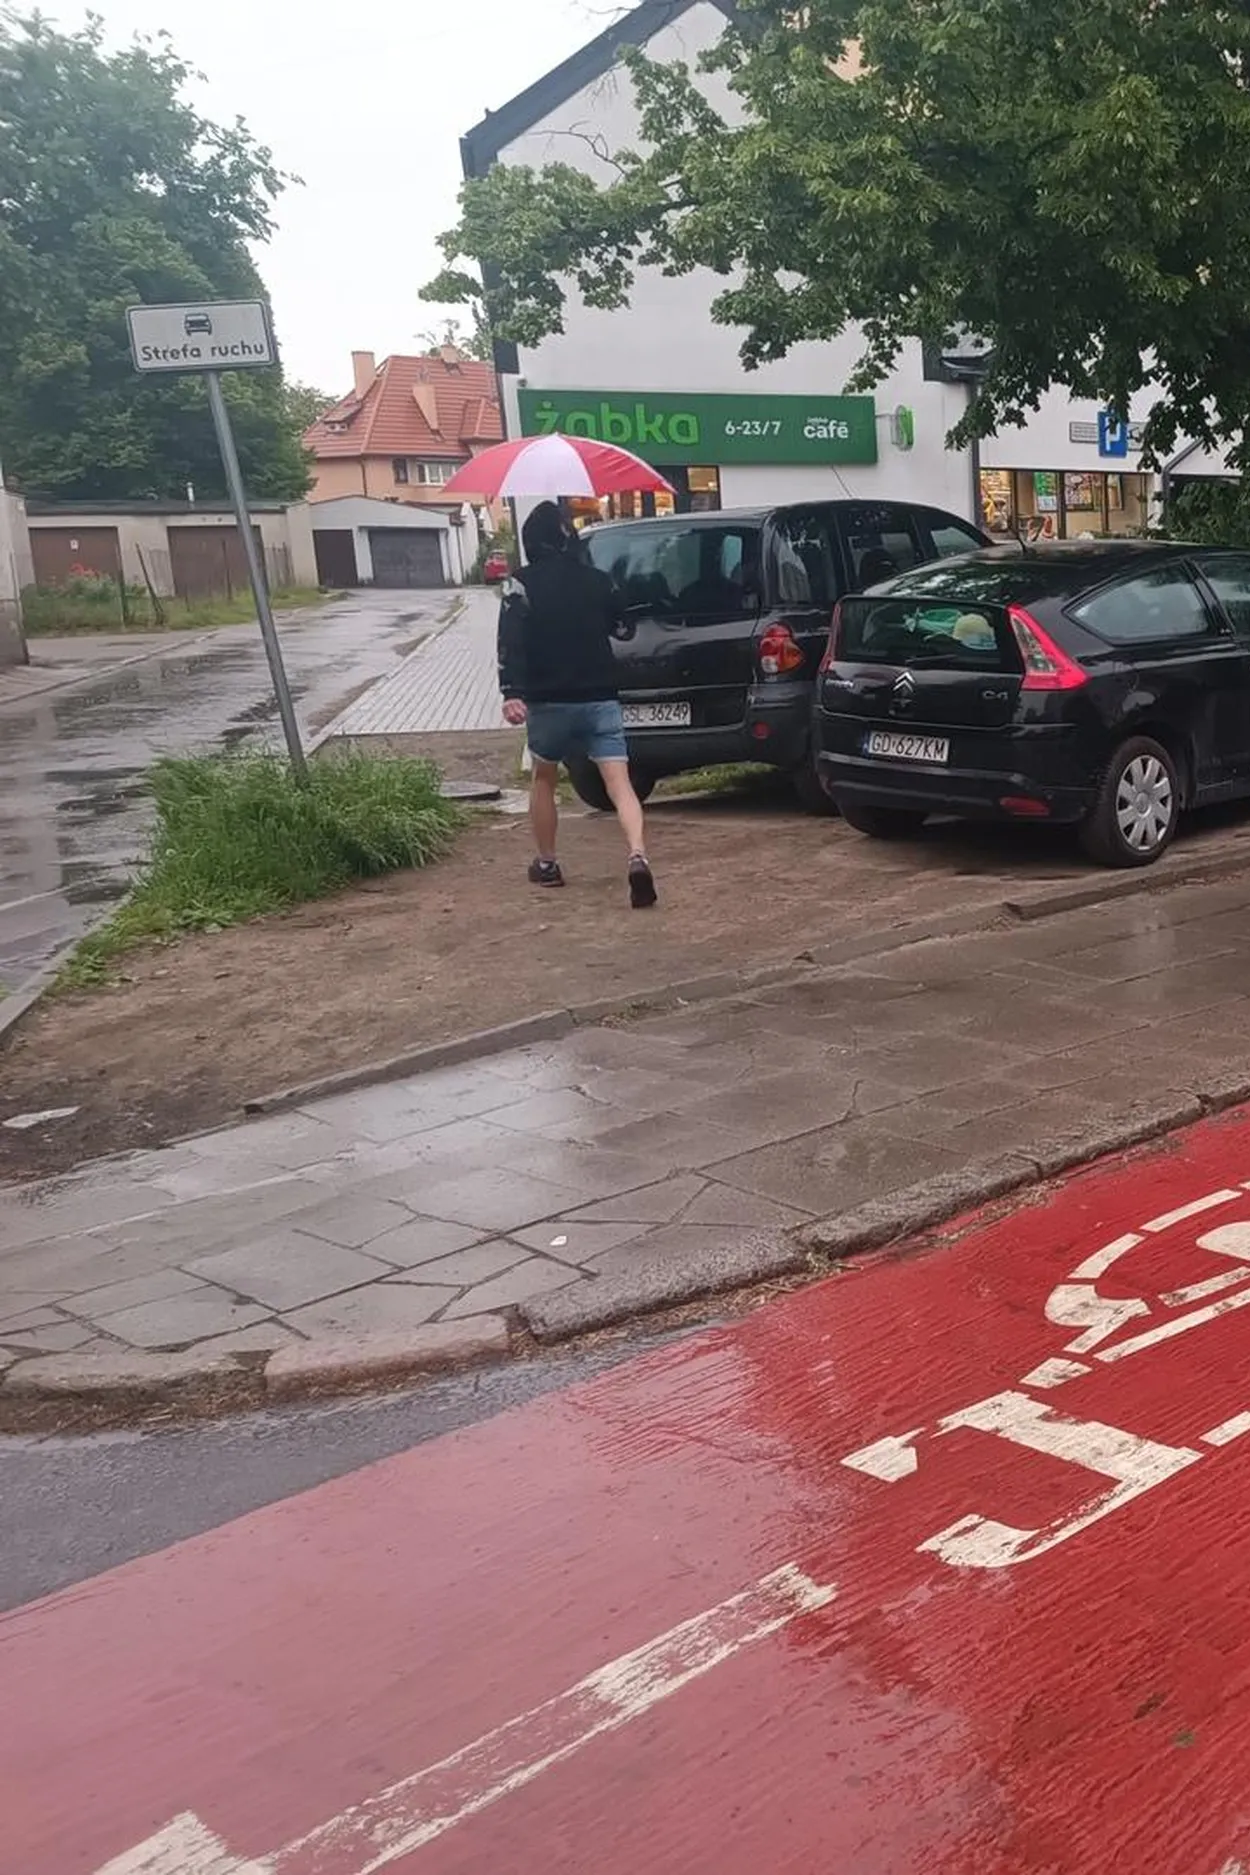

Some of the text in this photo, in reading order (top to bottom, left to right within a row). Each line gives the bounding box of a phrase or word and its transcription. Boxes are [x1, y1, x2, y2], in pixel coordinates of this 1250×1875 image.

[141, 341, 265, 362] Strefa ruchu
[724, 420, 782, 435] 6-23/7
